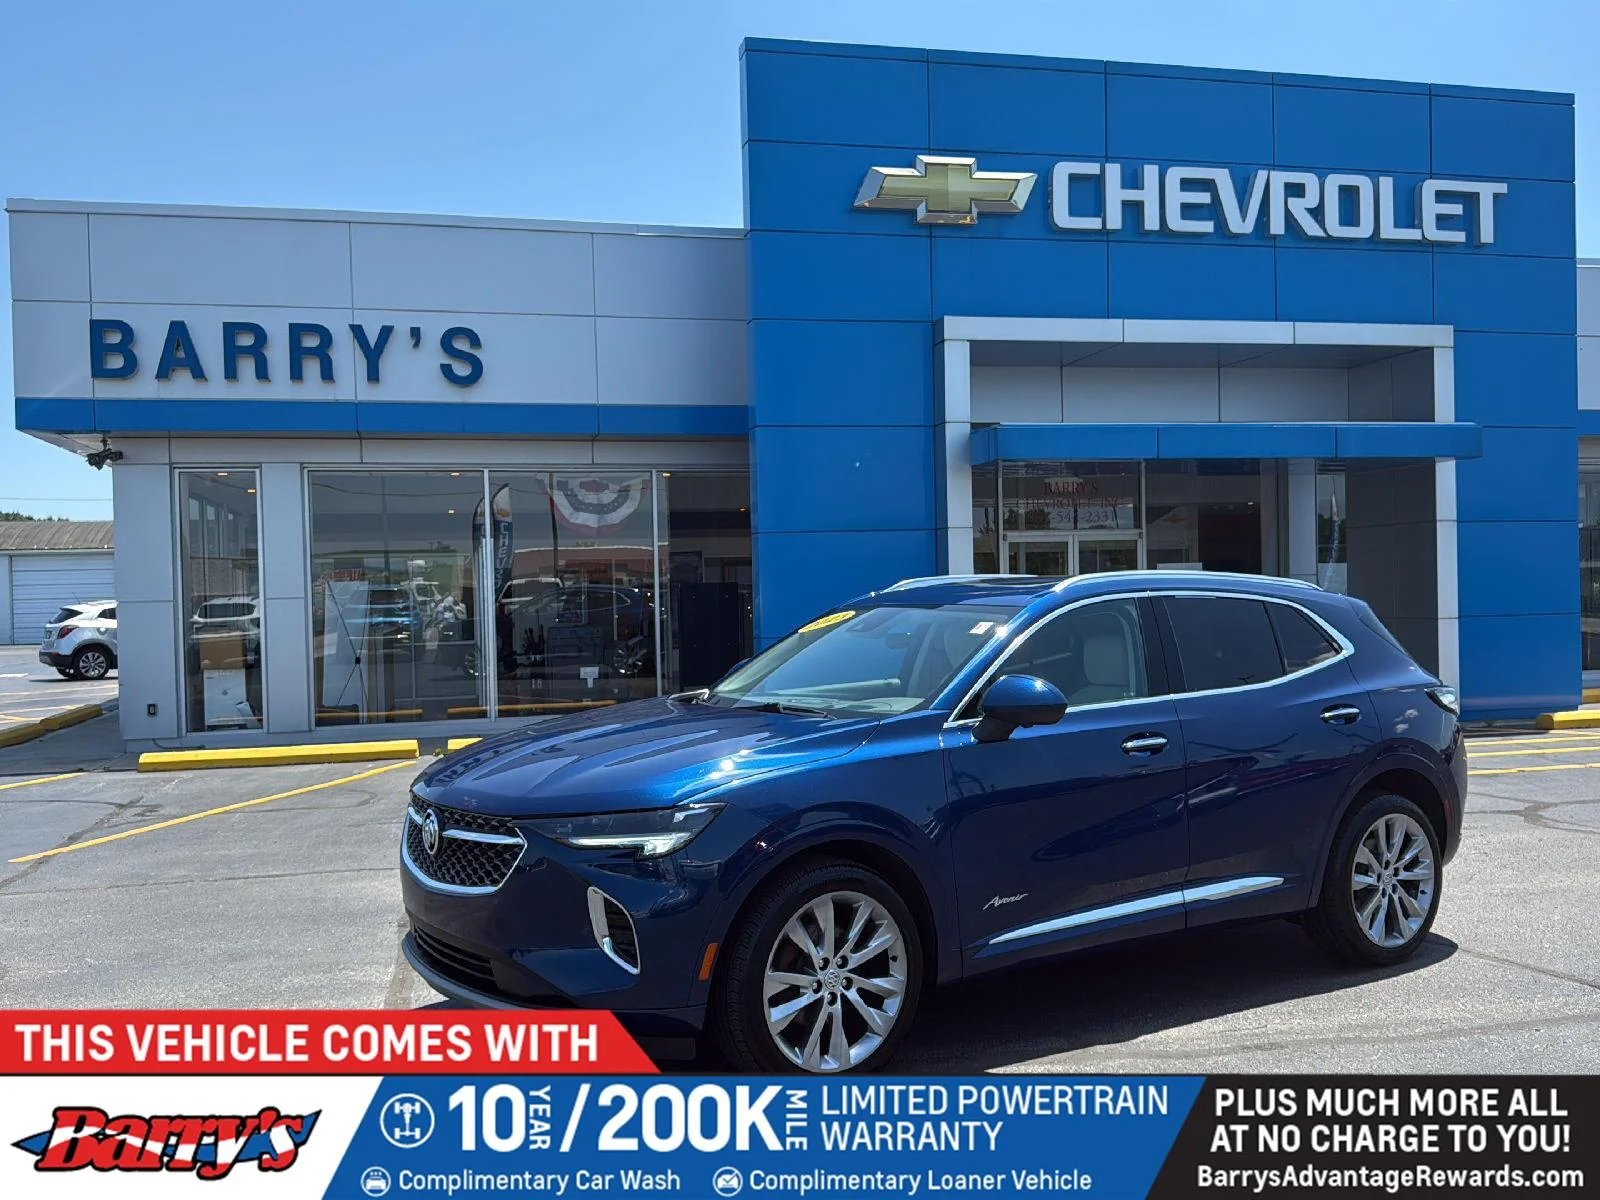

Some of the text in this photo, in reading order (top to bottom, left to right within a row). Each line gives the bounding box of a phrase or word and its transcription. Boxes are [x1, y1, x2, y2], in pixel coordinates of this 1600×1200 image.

[1051, 161, 1508, 245] CHEVROLET
[89, 318, 484, 387] BARRY'S
[1043, 481, 1099, 496] BARRY'S
[982, 893, 1029, 911] Avenir
